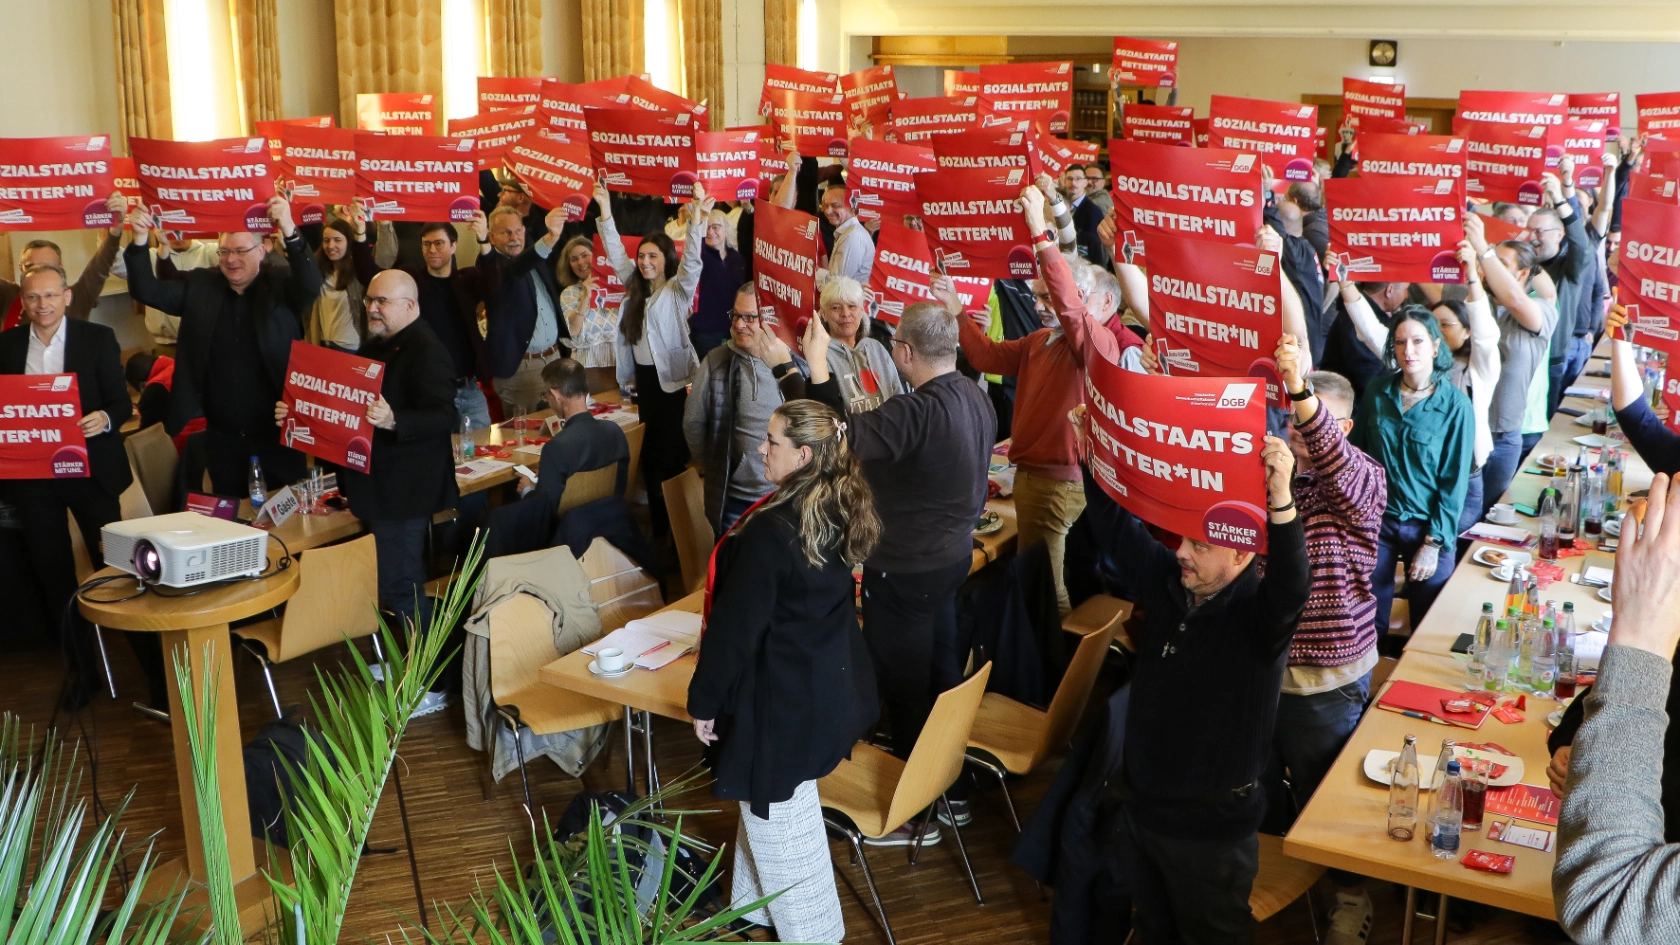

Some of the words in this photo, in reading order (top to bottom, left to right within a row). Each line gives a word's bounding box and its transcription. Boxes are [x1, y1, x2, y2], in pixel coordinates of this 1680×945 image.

[1116, 48, 1175, 62] SOZIALSTAATS
[767, 78, 833, 94] SOZIALSTAATS
[984, 82, 1068, 94] SOZIALSTAATS
[1345, 91, 1402, 107] SOZIALSTAATS
[774, 107, 843, 121] SOZIALSTAATS
[895, 113, 976, 126] SOZIALSTAATS
[1462, 111, 1563, 125] SOZIALSTAATS
[451, 118, 536, 138] SOZIALSTAATS
[1126, 117, 1190, 128] SOZIALSTAATS
[1214, 117, 1310, 138] SOZIALSTAATS
[591, 131, 691, 147] SOZIALSTAATS
[0, 161, 107, 178] ZIALSTAATS
[360, 159, 474, 173] SOZIALSTAATS
[939, 155, 1027, 168] SOZIALSTAATS
[1362, 160, 1462, 178] SOZIALSTAATS
[140, 163, 267, 180] SOZIALSTAATS
[1117, 175, 1255, 207] SOZIALSTAATS
[923, 200, 1023, 216] SOZIALSTAATS
[1333, 207, 1455, 222] SOZIALSTAATS
[755, 237, 814, 277] SOZIALSTAATS
[1257, 265, 1271, 274] DGB
[1152, 274, 1276, 315] SOZIALSTAATS
[289, 371, 375, 406] SOZIALSTAATS
[1085, 366, 1253, 455] SOZIALSTAATS
[1221, 398, 1246, 407] DGB
[0, 403, 75, 419] STAATS
[277, 496, 297, 516] Gäste
[1208, 522, 1257, 538] STÄRKER
[1209, 530, 1229, 541] MIT
[1230, 533, 1256, 546] UNS.
